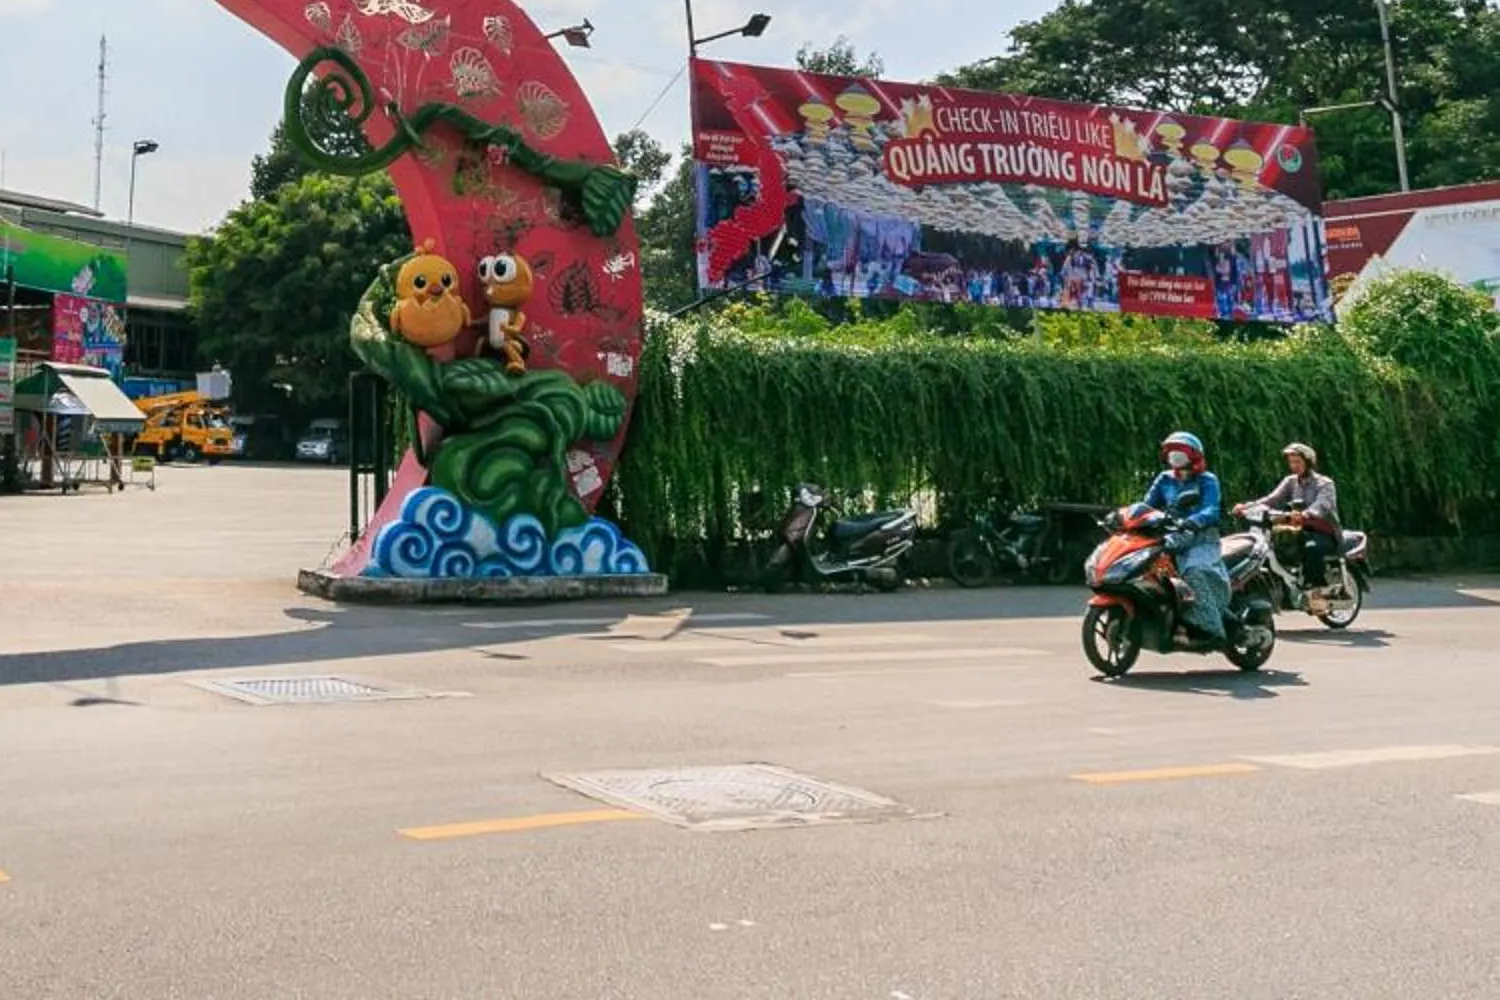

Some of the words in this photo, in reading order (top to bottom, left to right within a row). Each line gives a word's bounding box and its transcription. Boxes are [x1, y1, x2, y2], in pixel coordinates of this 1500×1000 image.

[937, 107, 1020, 135] CHECK-IN
[1020, 111, 1071, 144] TRIỆU
[1075, 119, 1112, 150] LIKE
[889, 135, 977, 181] QUẢNG
[977, 140, 1077, 182] TRƯỜNG
[1081, 152, 1132, 193] NÓN
[1137, 165, 1164, 201] LÁ
